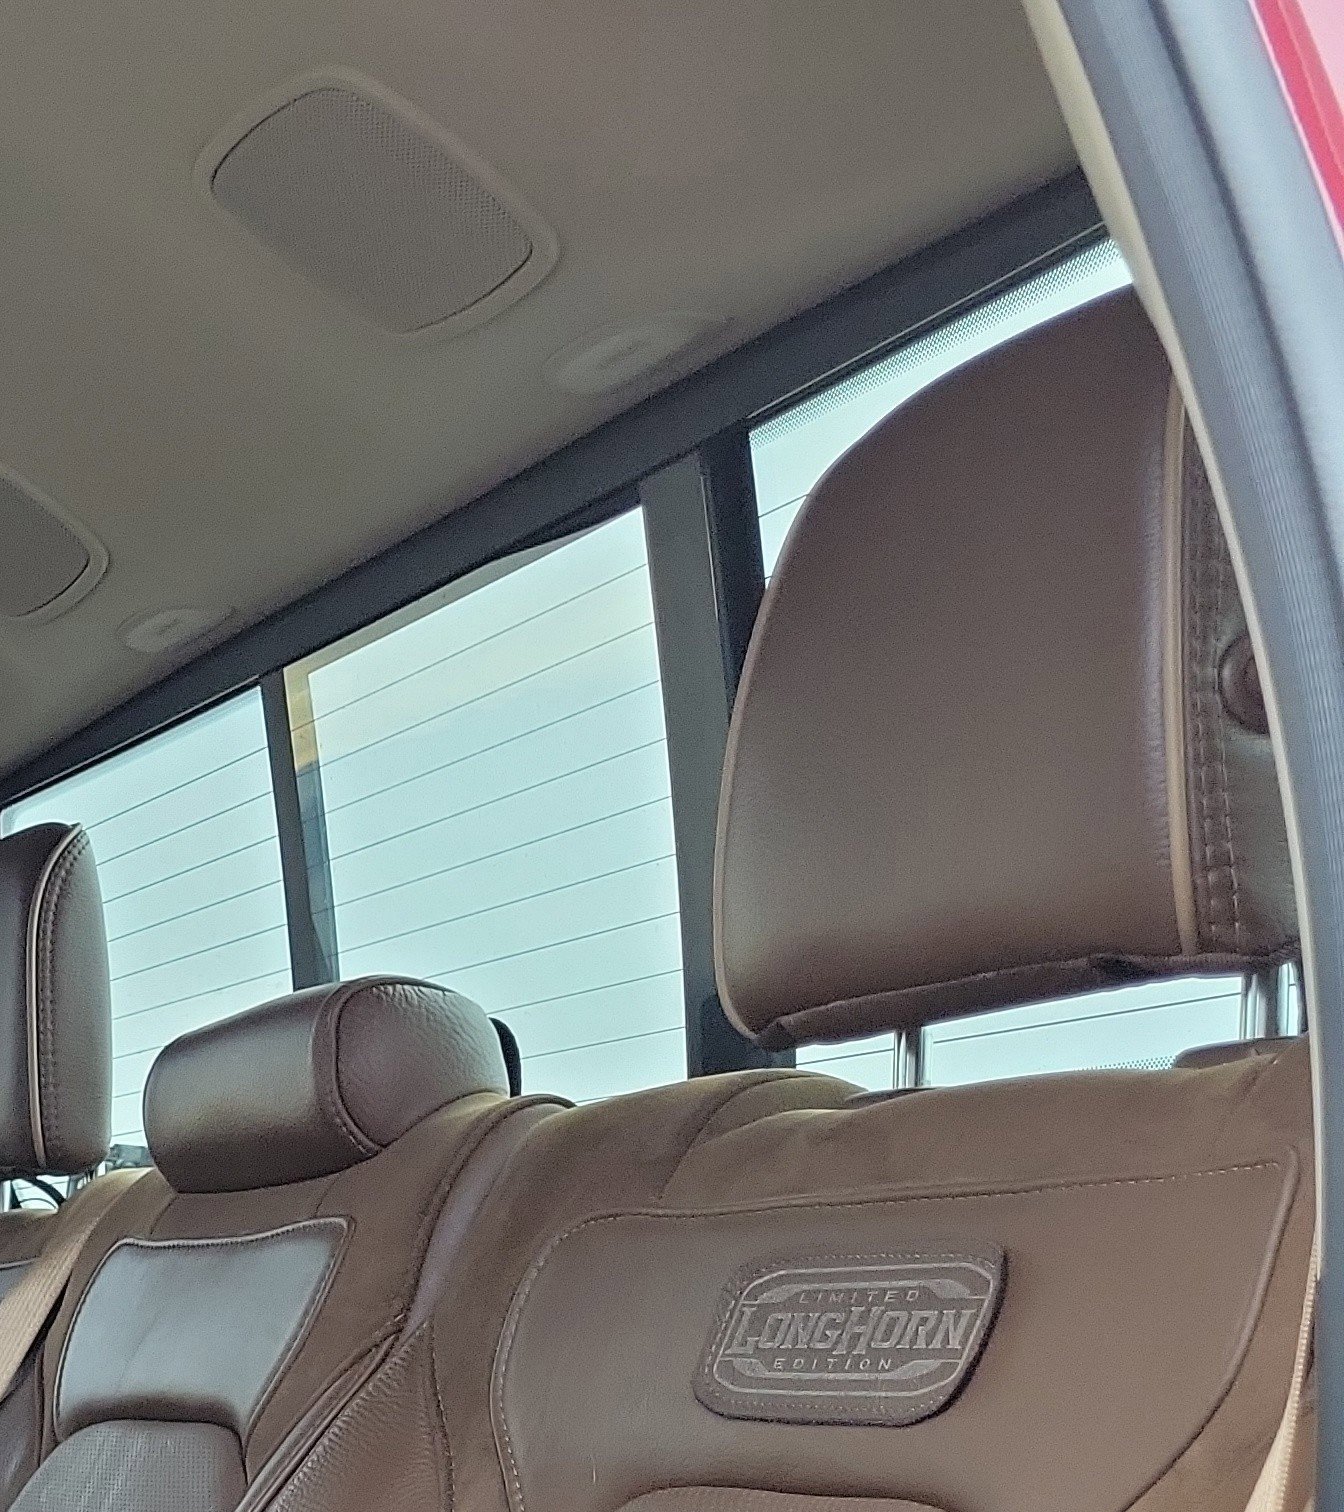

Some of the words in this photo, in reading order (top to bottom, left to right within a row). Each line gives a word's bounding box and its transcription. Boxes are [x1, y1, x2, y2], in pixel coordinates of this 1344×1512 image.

[799, 1289, 920, 1304] LIMITED
[724, 1305, 977, 1355] LONGHORN
[773, 1358, 892, 1372] EDITION
